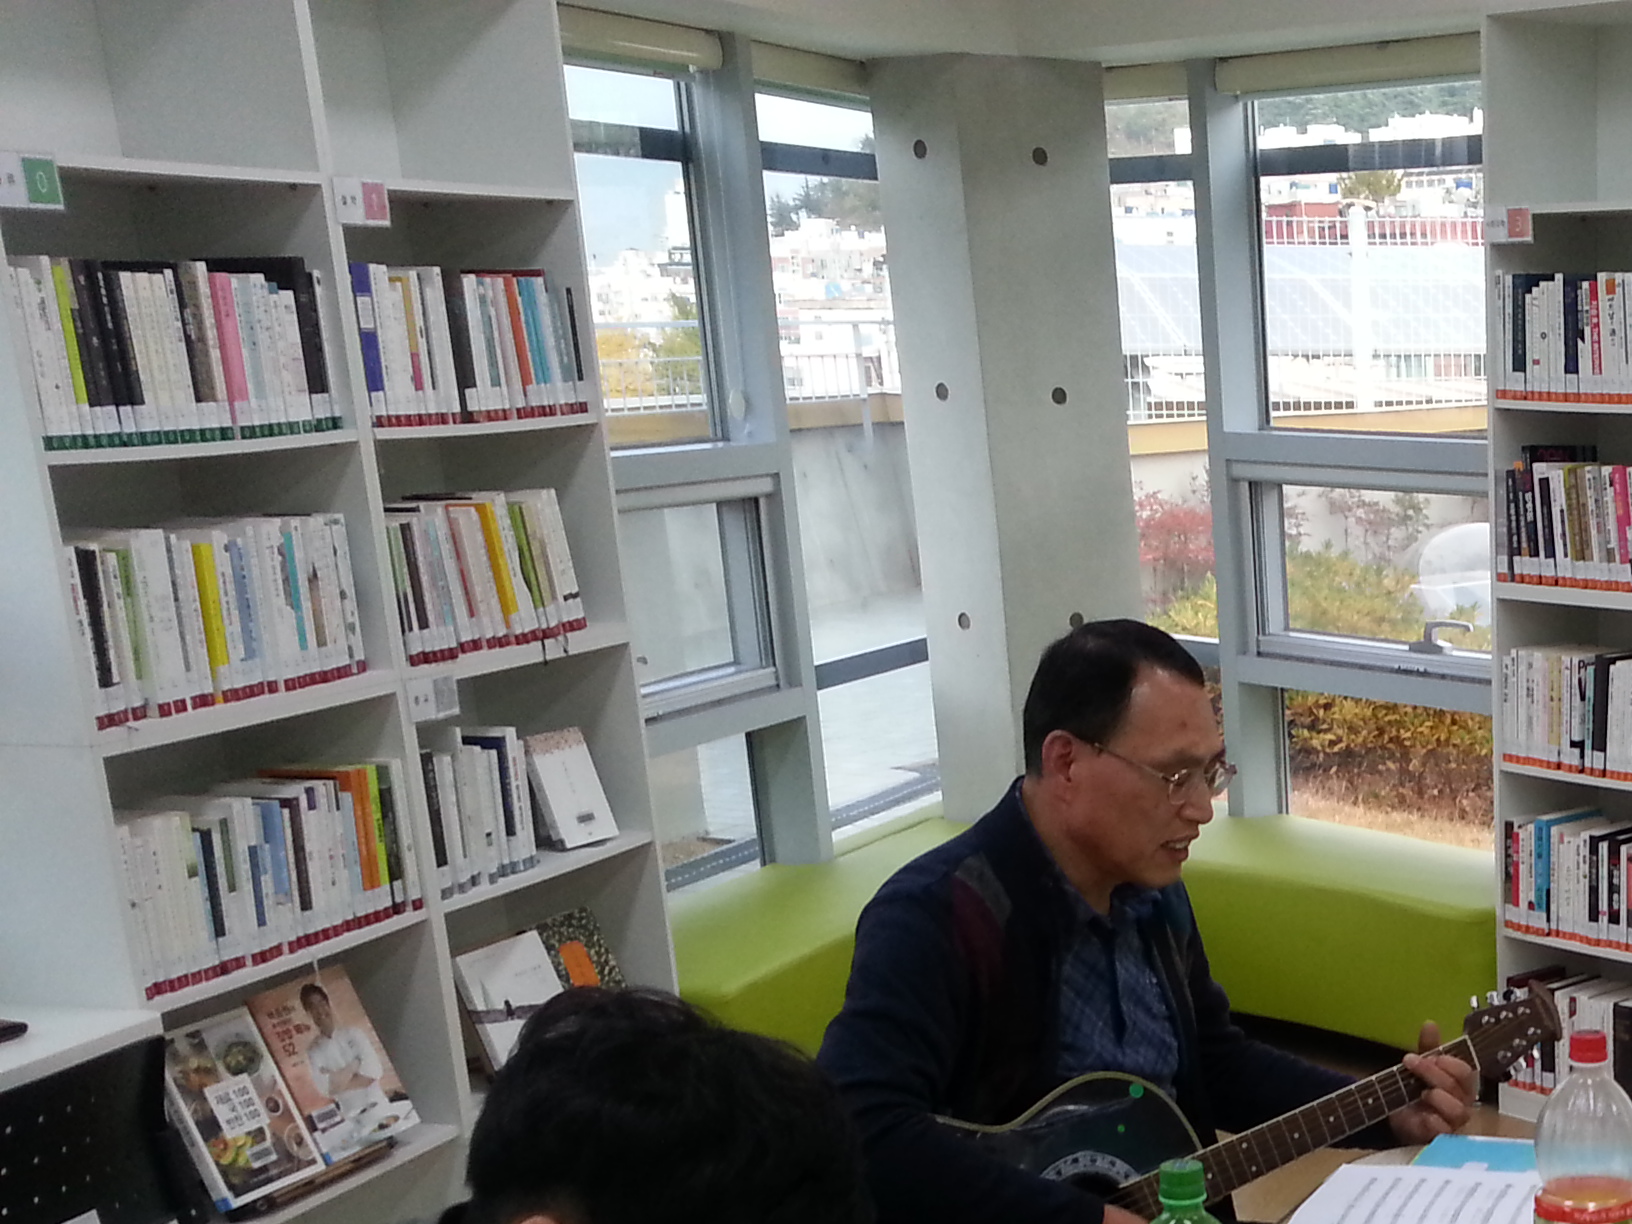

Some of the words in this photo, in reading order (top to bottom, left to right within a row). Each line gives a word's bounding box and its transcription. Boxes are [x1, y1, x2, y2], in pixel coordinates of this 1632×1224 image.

[232, 1084, 250, 1099] 100
[238, 1096, 256, 1110] 100
[243, 1107, 261, 1122] 100
